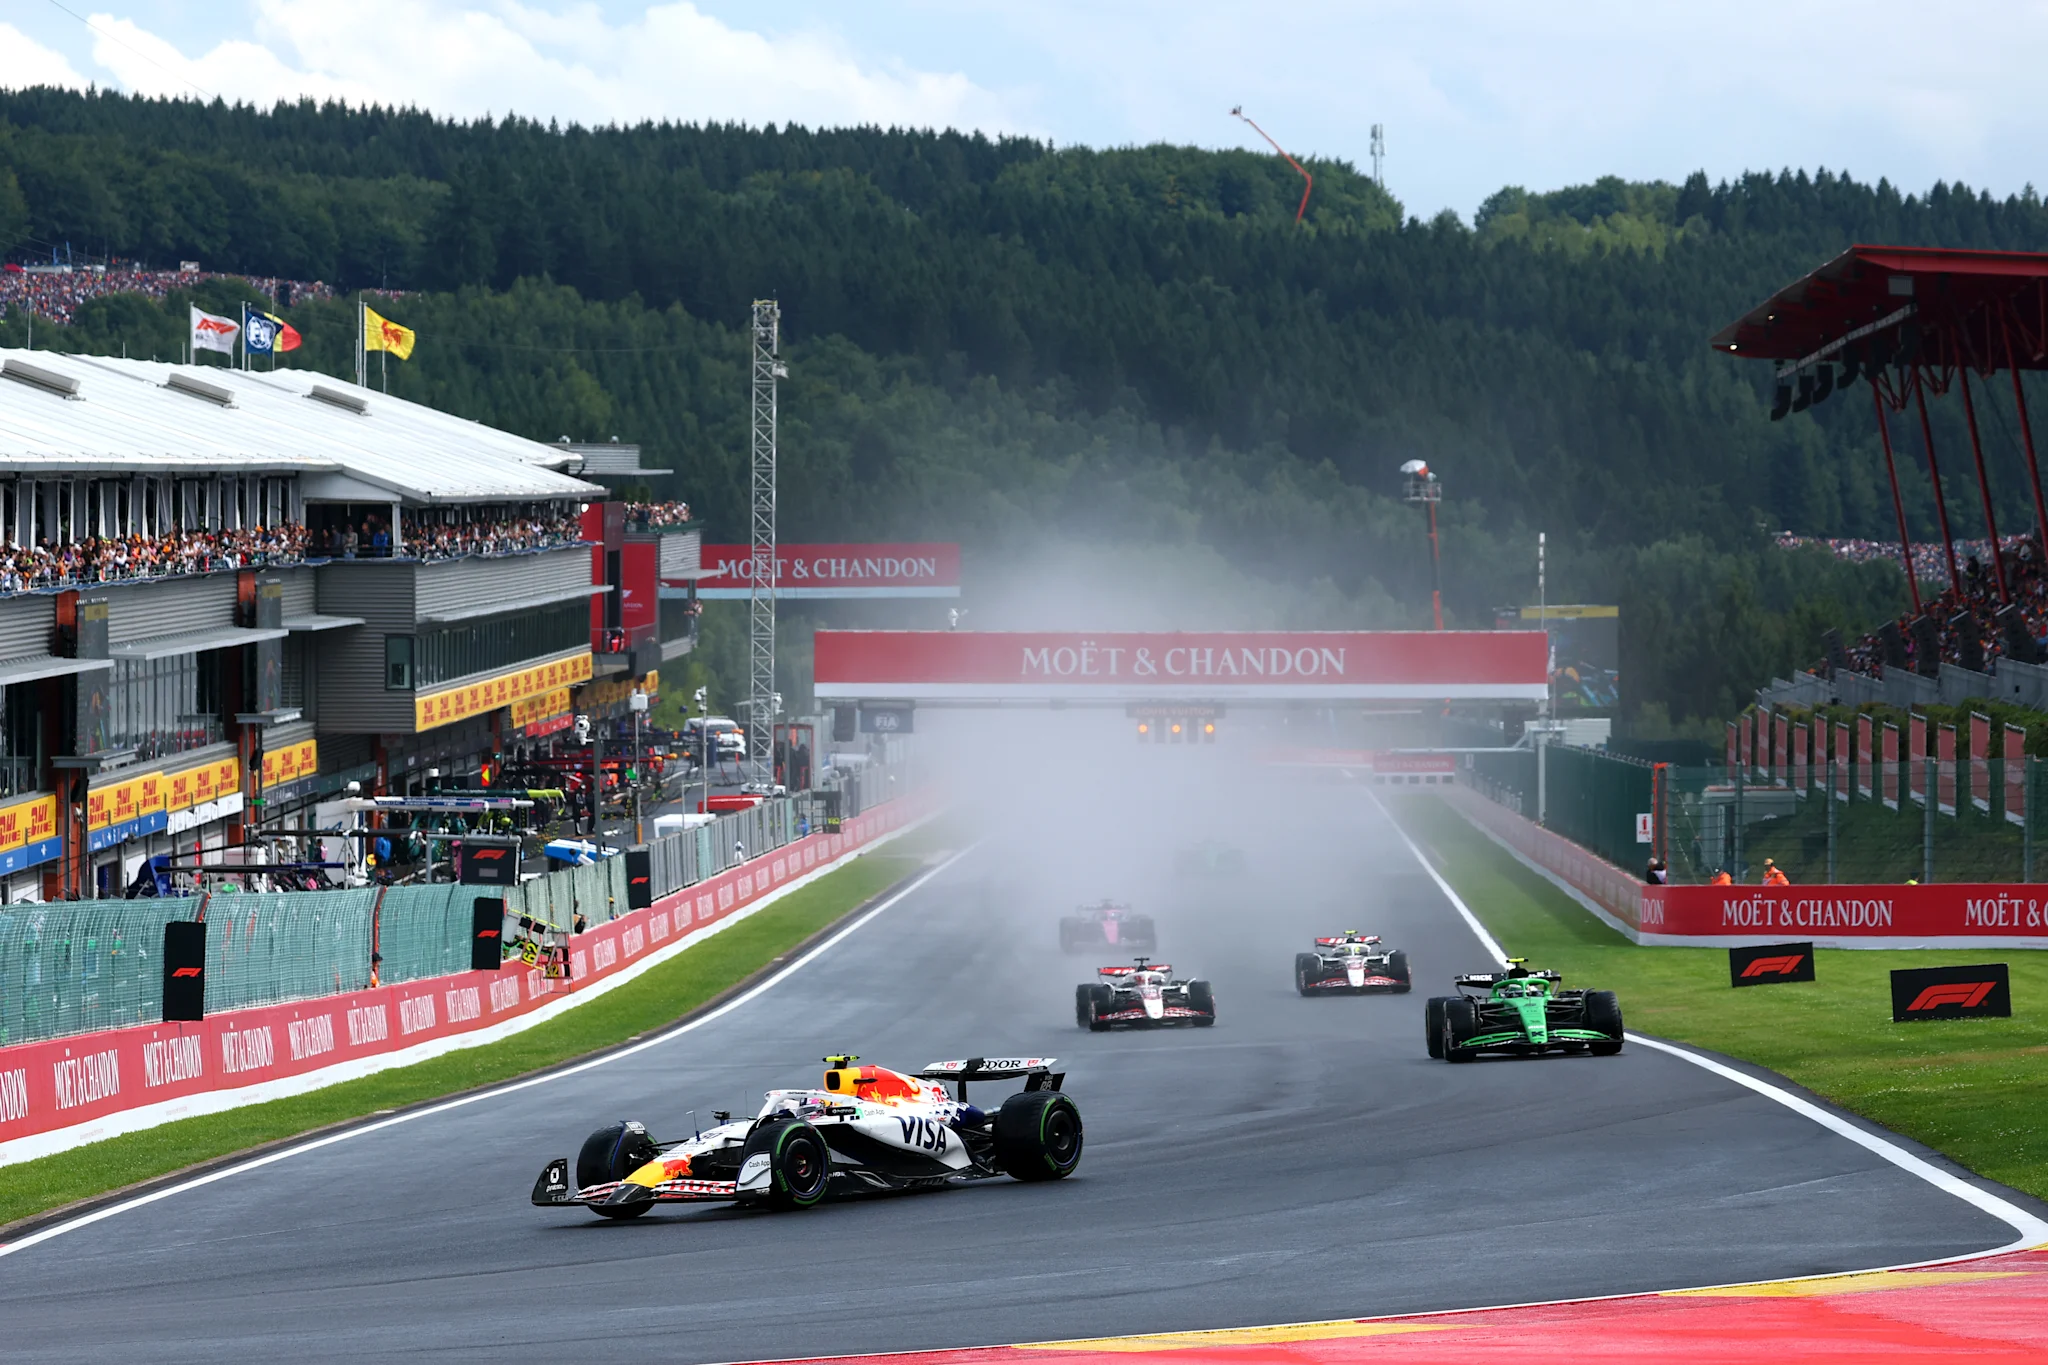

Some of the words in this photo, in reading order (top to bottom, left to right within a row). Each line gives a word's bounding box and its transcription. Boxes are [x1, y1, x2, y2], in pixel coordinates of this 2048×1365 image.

[792, 558, 809, 578] &
[813, 558, 936, 578] CHANDON
[1021, 641, 1126, 675] MOËT
[1133, 648, 1158, 676] &
[1164, 647, 1347, 676] CHANDON
[875, 716, 899, 728] FIA
[1641, 898, 1665, 925] DON
[1722, 893, 1777, 926] MOËT
[1780, 900, 1794, 926] &
[1796, 900, 1893, 927] CHANDON
[1965, 893, 2023, 927] MOËT
[2026, 899, 2041, 927] &
[169, 1034, 202, 1082] CHANDON
[963, 1060, 1021, 1069] DOR
[0, 1068, 28, 1122] NDON
[54, 1048, 78, 1110] MOËT
[84, 1049, 120, 1104] CHANDON
[897, 1116, 947, 1155] VISA
